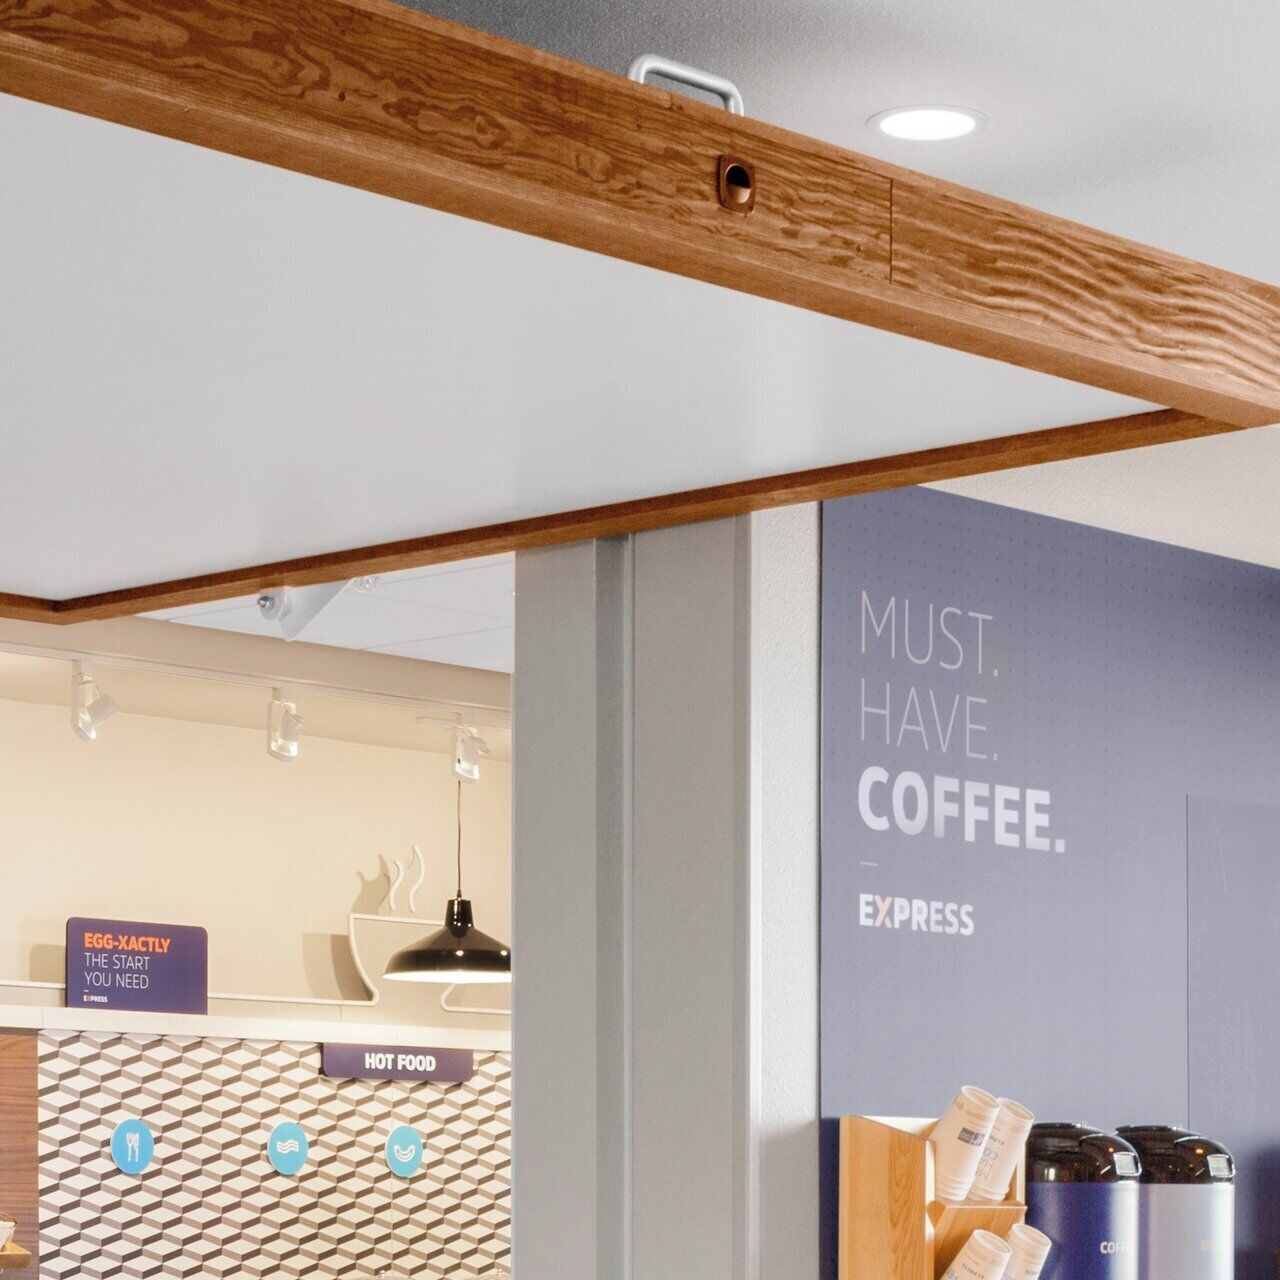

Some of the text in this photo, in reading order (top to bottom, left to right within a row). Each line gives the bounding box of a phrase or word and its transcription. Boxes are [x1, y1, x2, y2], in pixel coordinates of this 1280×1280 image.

[861, 590, 1000, 677] MUST.
[861, 677, 999, 762] HAVE.
[858, 765, 1066, 854] COFFEE.
[858, 892, 975, 936] EXPRESS
[83, 932, 171, 954] EGG-XACTLY
[84, 952, 151, 971] THE START
[84, 971, 150, 989] YOU NEED
[364, 1053, 437, 1072] HOT FOOD
